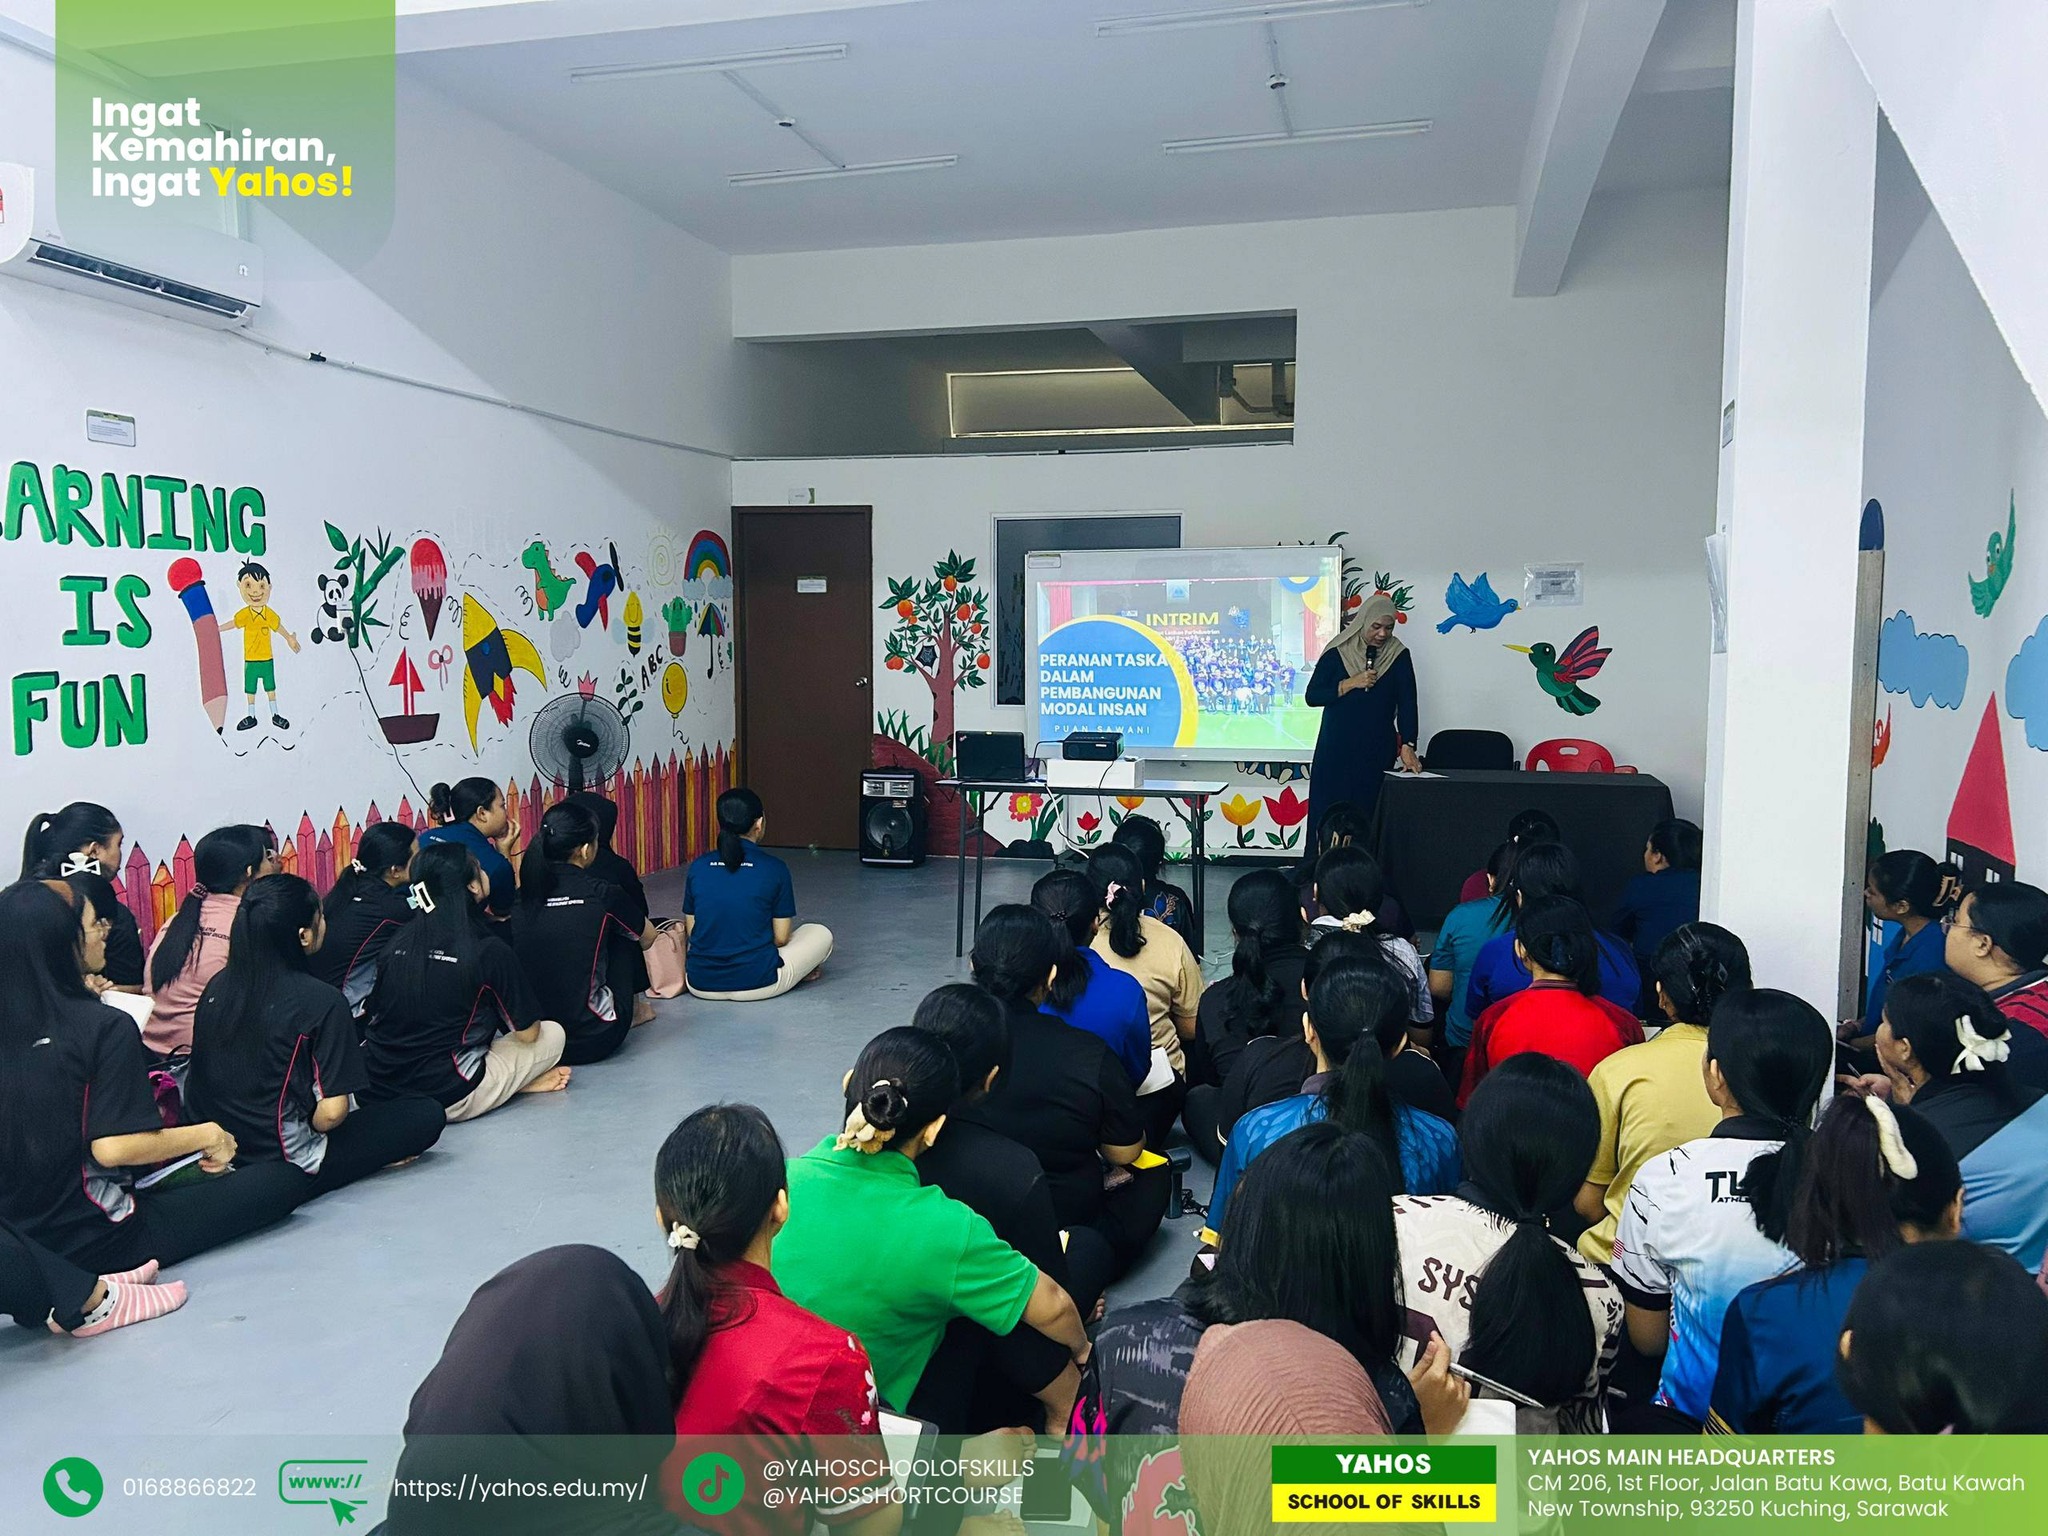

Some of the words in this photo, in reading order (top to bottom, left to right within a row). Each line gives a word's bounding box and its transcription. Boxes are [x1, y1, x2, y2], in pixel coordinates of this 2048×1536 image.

[0, 460, 266, 556] ARNING
[59, 573, 152, 648] IS
[1146, 611, 1219, 627] INTRIM
[641, 643, 663, 691] ABC
[1039, 653, 1112, 668] PERANAN
[1115, 653, 1169, 668] TASKA
[1040, 669, 1095, 684] DALAM
[1040, 686, 1162, 701] PEMBANGUNAN
[11, 671, 148, 756] FUN
[1041, 702, 1096, 716] MODAL
[1098, 702, 1148, 717] INSAN
[1054, 724, 1089, 733] PUAN
[1097, 725, 1150, 735] SAWANI
[1418, 1256, 1481, 1312] SYS
